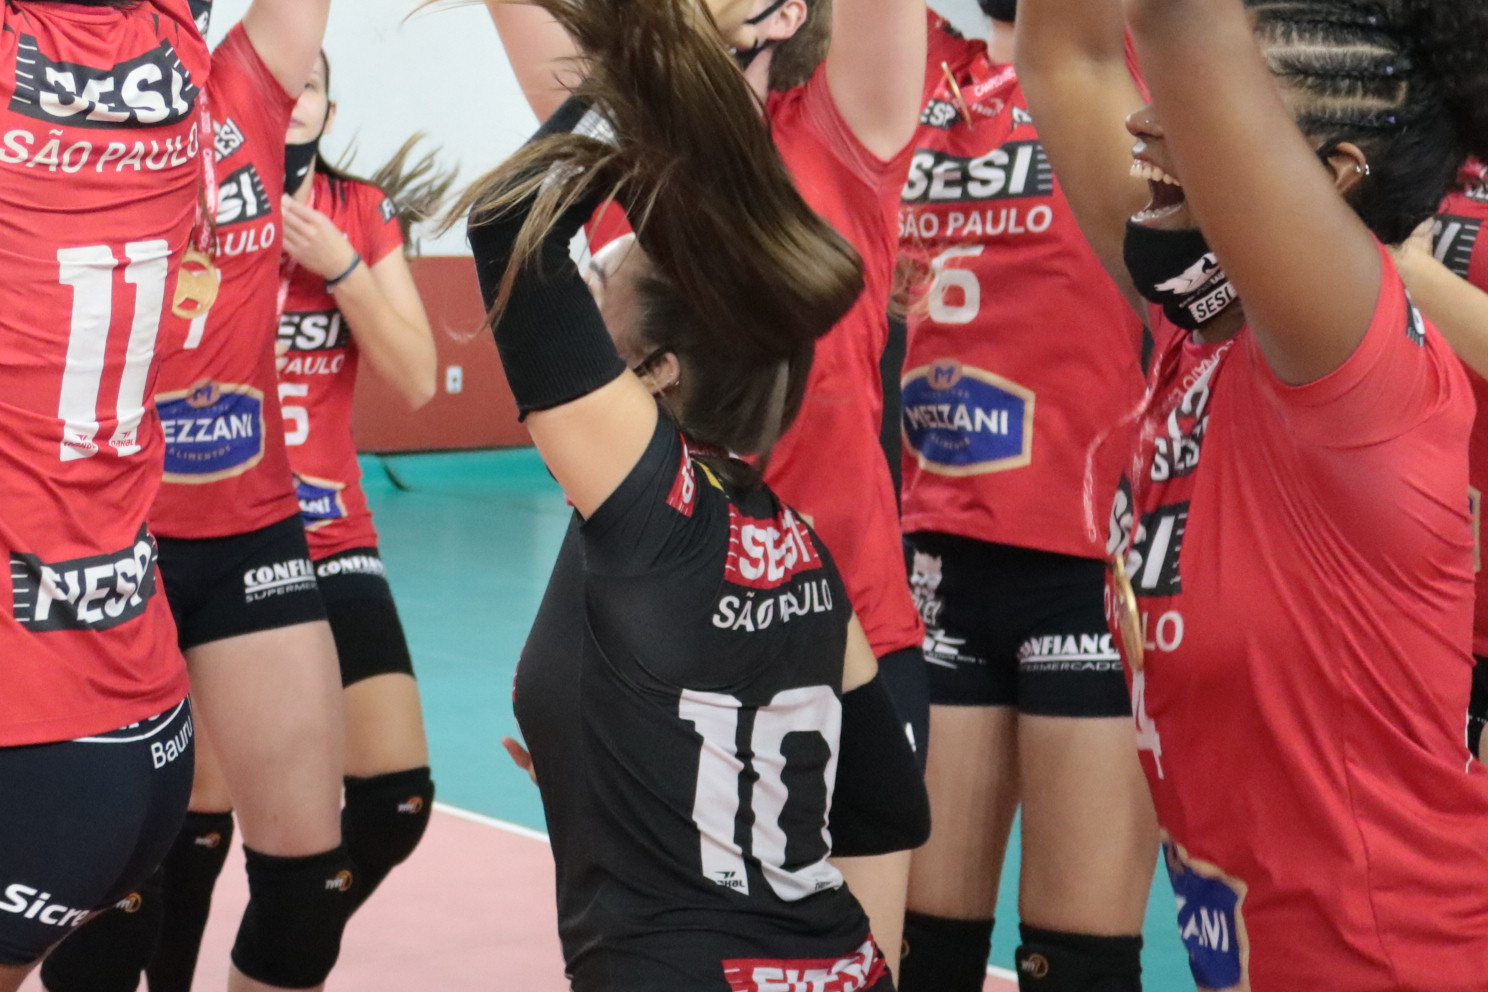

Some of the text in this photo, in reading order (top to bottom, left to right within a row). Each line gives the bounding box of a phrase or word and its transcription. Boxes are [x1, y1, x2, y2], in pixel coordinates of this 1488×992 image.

[96, 120, 199, 173] PAULO
[946, 204, 1053, 237] PAULO
[927, 244, 986, 325] 6
[1195, 286, 1232, 319] SESI
[57, 239, 173, 462] 11
[713, 591, 775, 632] SÃO
[679, 685, 843, 902] 10
